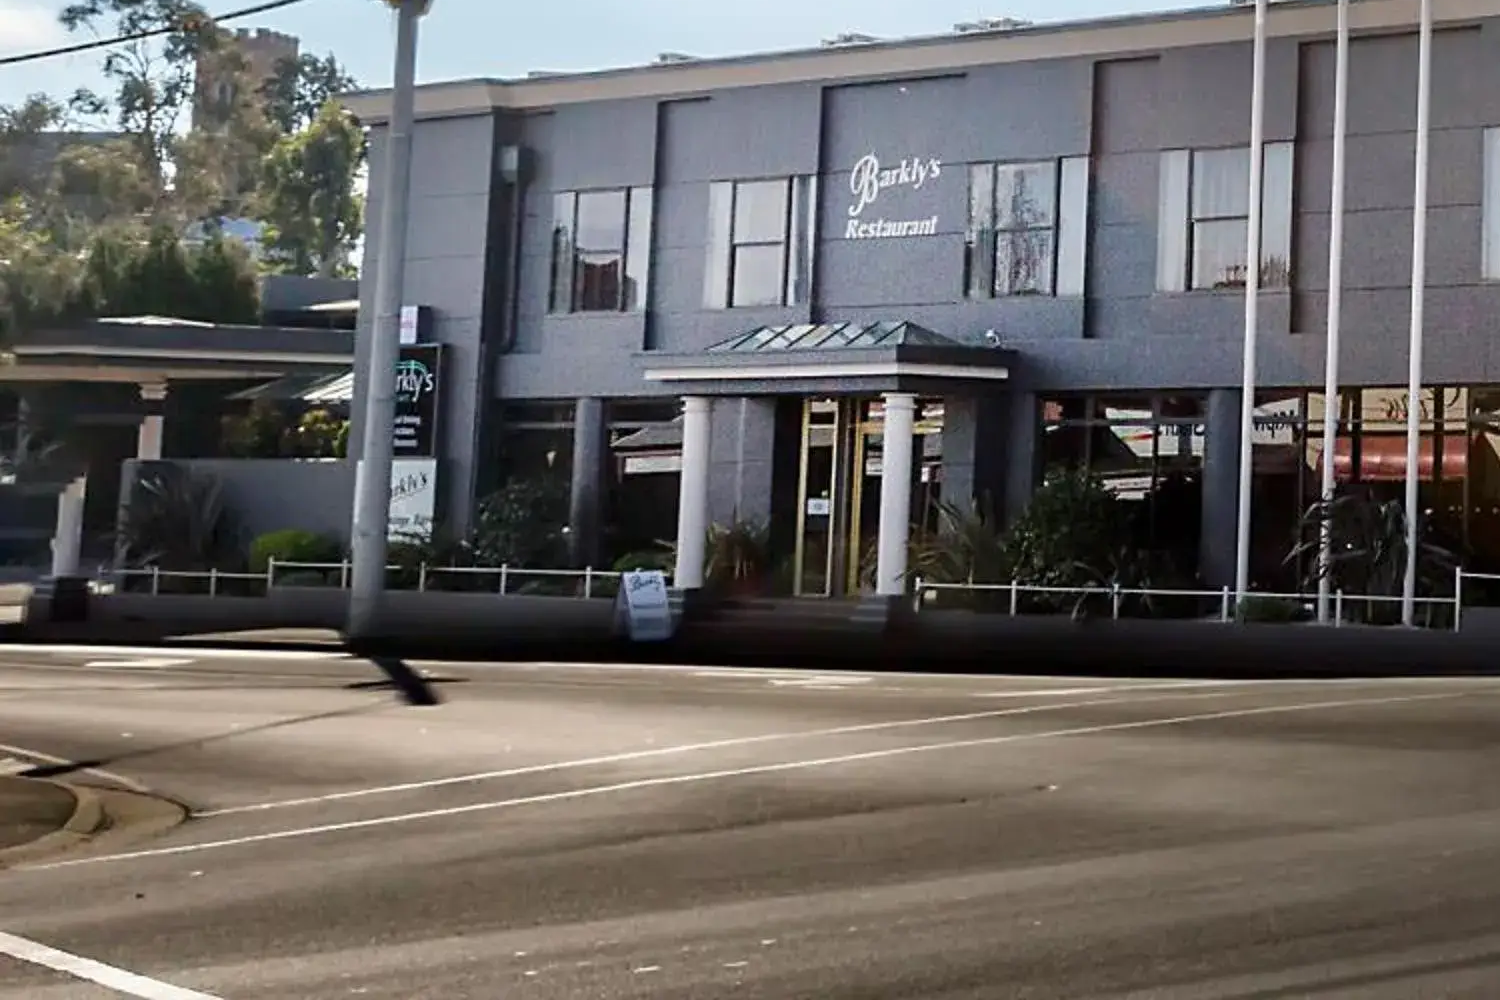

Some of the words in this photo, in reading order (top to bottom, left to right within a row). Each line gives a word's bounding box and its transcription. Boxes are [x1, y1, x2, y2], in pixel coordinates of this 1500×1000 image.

[847, 154, 941, 217] Barkly's
[844, 215, 938, 239] Restaurant
[395, 360, 433, 403] rkly's
